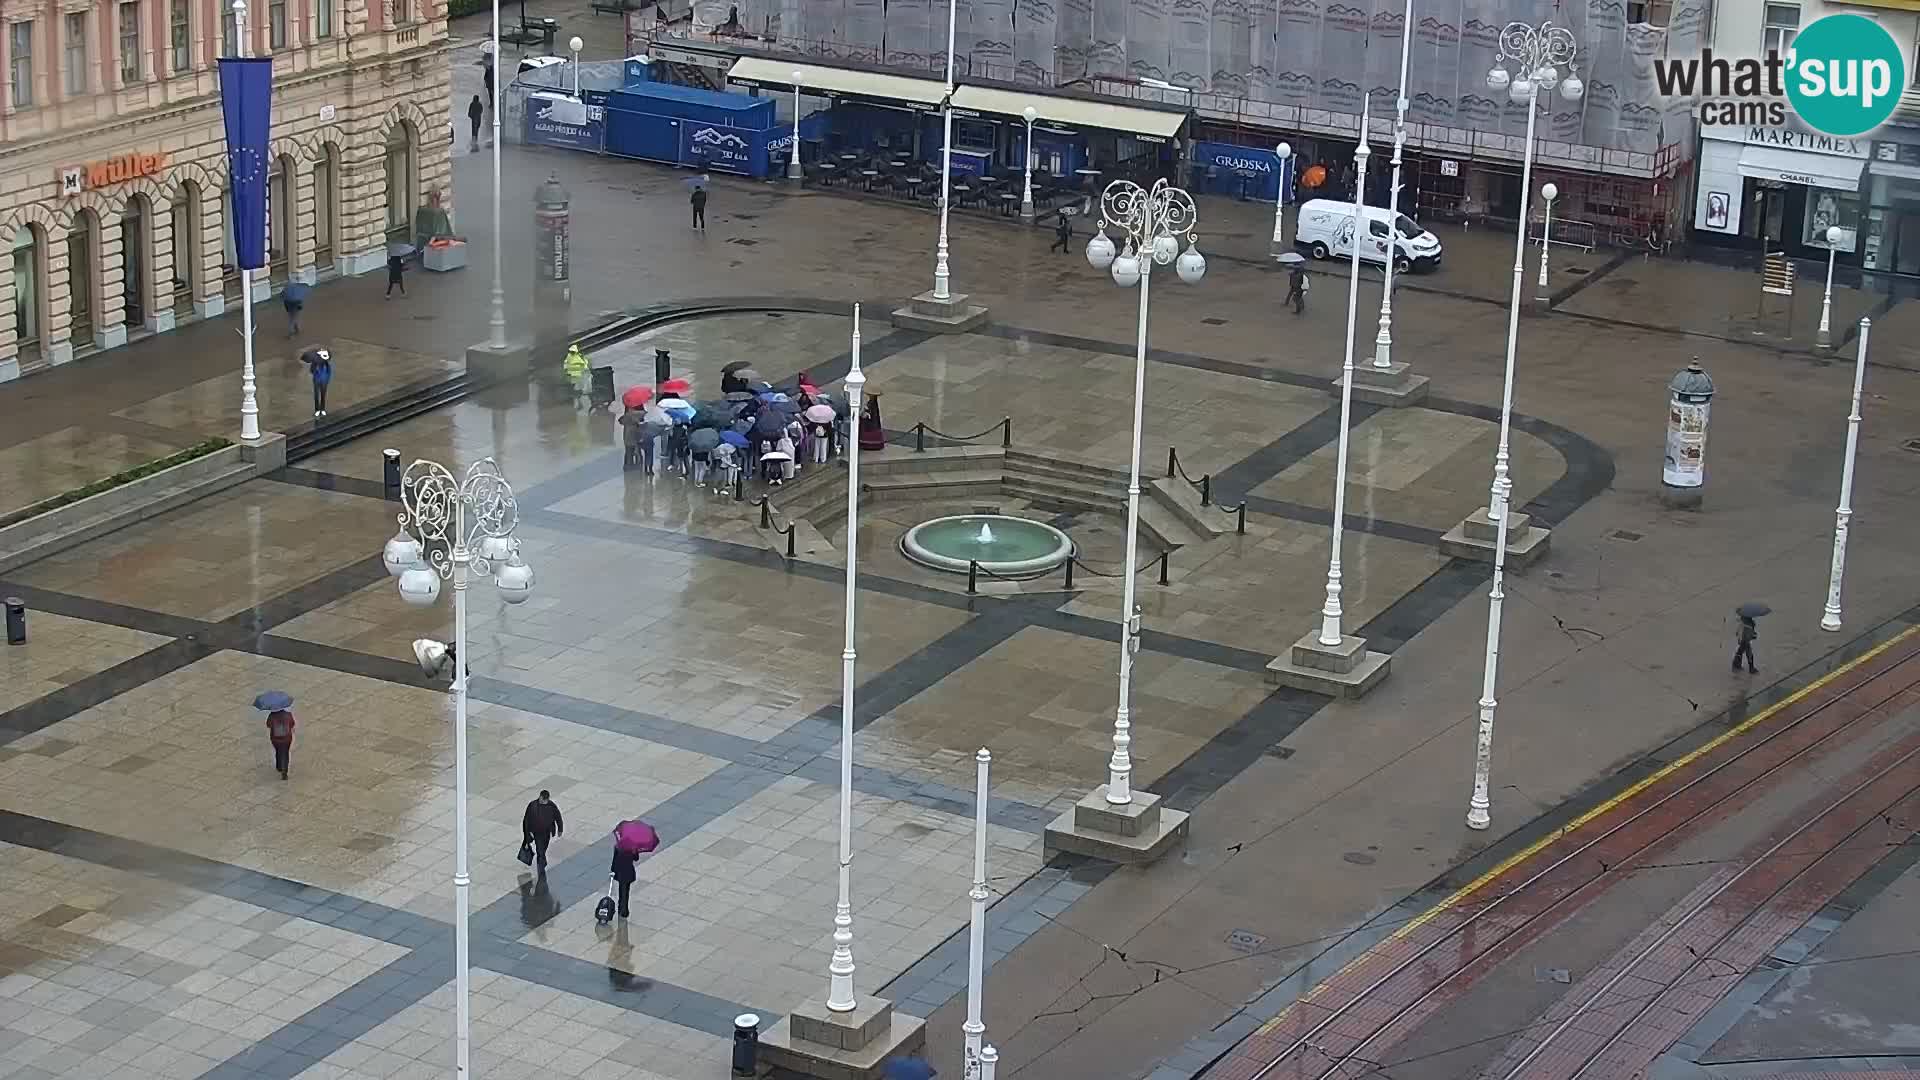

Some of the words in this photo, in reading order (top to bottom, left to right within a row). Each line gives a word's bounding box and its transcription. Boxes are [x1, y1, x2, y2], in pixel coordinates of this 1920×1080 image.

[1750, 127, 1860, 154] MARTIMEX
[65, 174, 77, 189] M
[88, 152, 162, 187] Müller
[1215, 155, 1271, 173] GRADSKA
[1780, 173, 1816, 184] CHANEL
